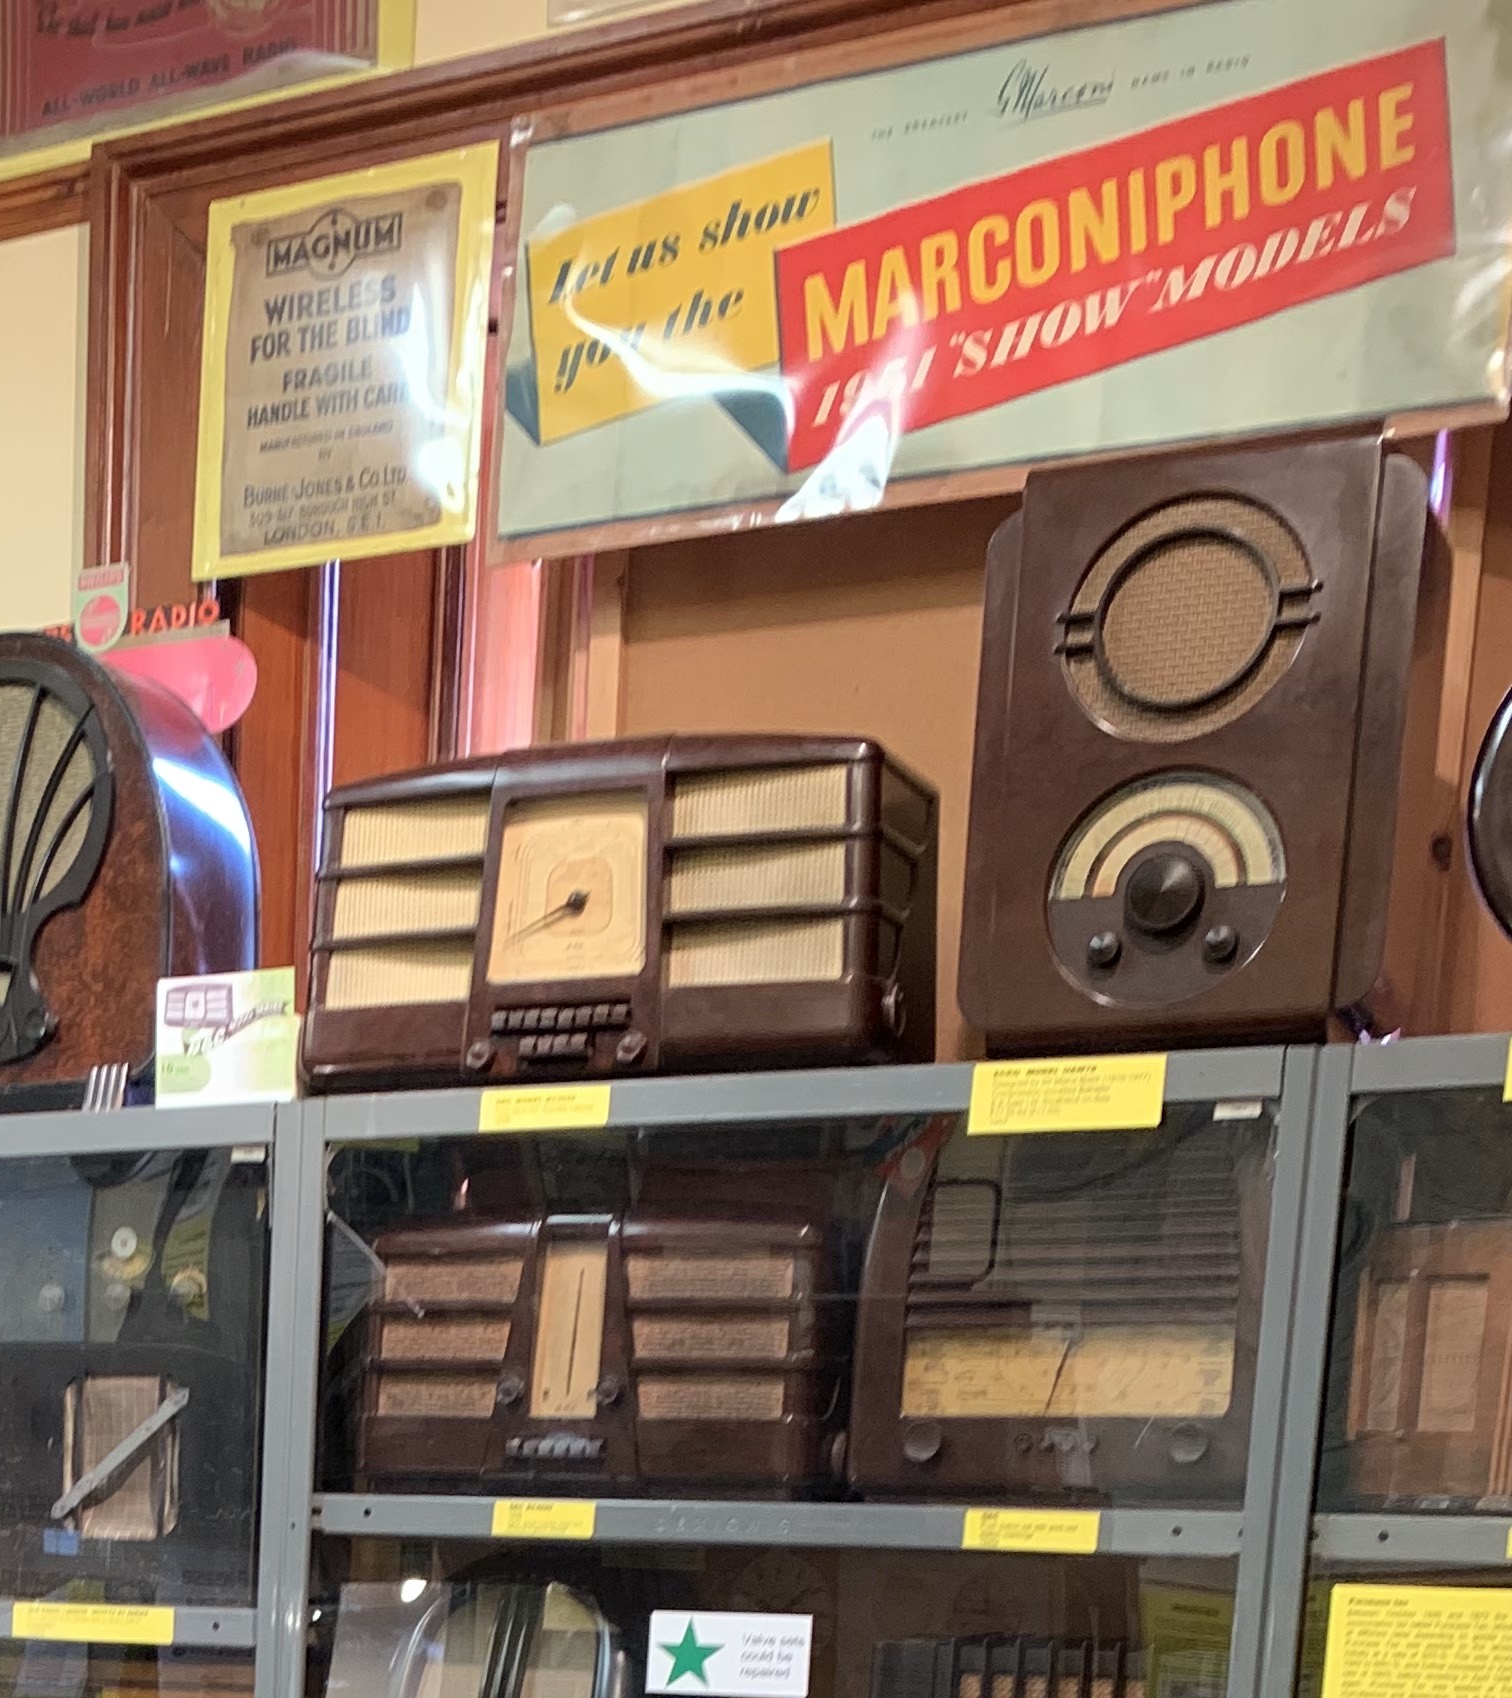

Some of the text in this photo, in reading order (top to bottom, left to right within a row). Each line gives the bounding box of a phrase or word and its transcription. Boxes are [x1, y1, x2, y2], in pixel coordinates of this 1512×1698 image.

[271, 213, 399, 270] MAGNUM
[626, 231, 681, 276] us
[698, 187, 821, 252] show
[804, 84, 1416, 363] MARCONIPHONE
[1152, 187, 1417, 312] MODELS
[264, 273, 396, 326] WIRELESS
[663, 287, 744, 341] the
[250, 330, 291, 365] FOR
[297, 318, 338, 353] THE
[282, 354, 372, 393] FRAGILE
[247, 396, 310, 430] HANDLE
[315, 387, 358, 416] WITH
[130, 600, 220, 635] RADIO
